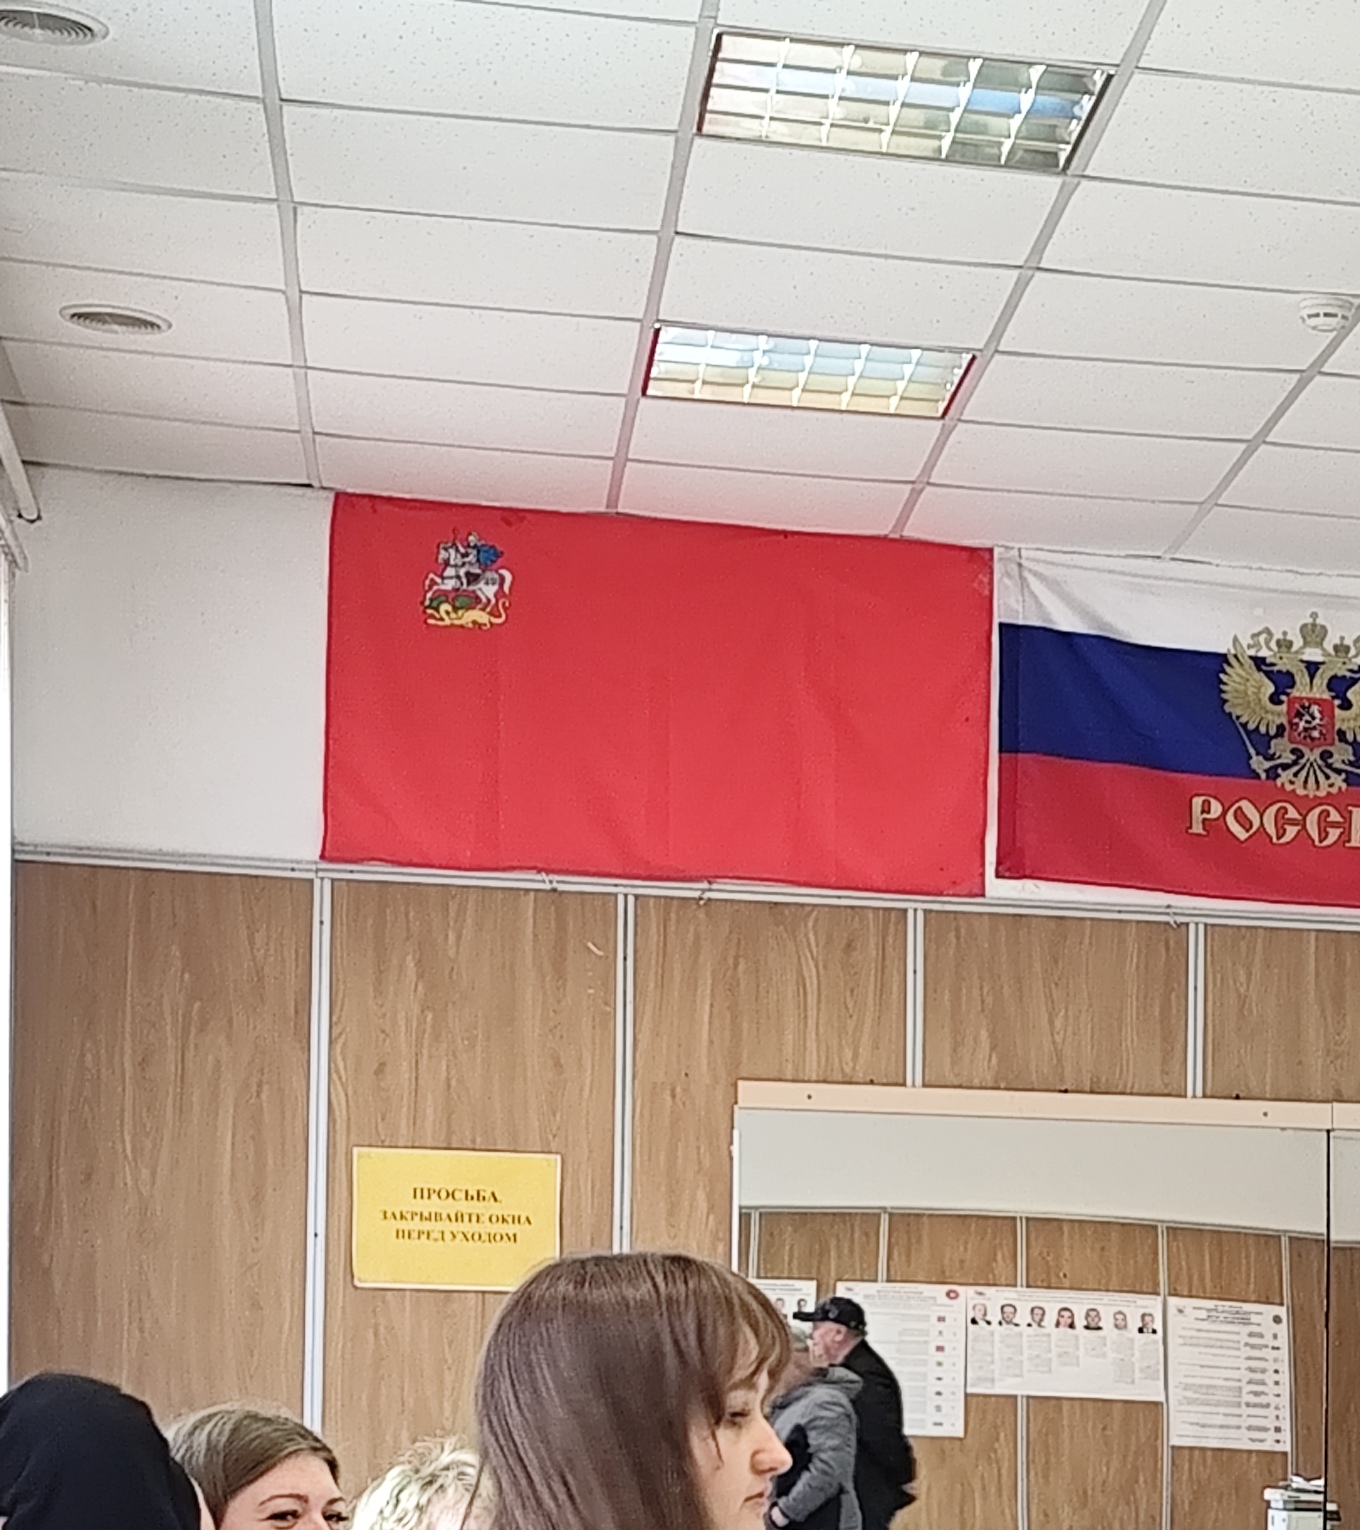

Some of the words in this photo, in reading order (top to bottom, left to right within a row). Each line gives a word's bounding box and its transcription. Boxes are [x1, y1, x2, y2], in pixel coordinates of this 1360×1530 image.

[380, 1208, 486, 1225] ЗАКРЫВАЙТЕ
[488, 1213, 533, 1227] ОКНА
[395, 1228, 446, 1243] ПЕРЕД
[449, 1230, 519, 1245] УХОДОМ
